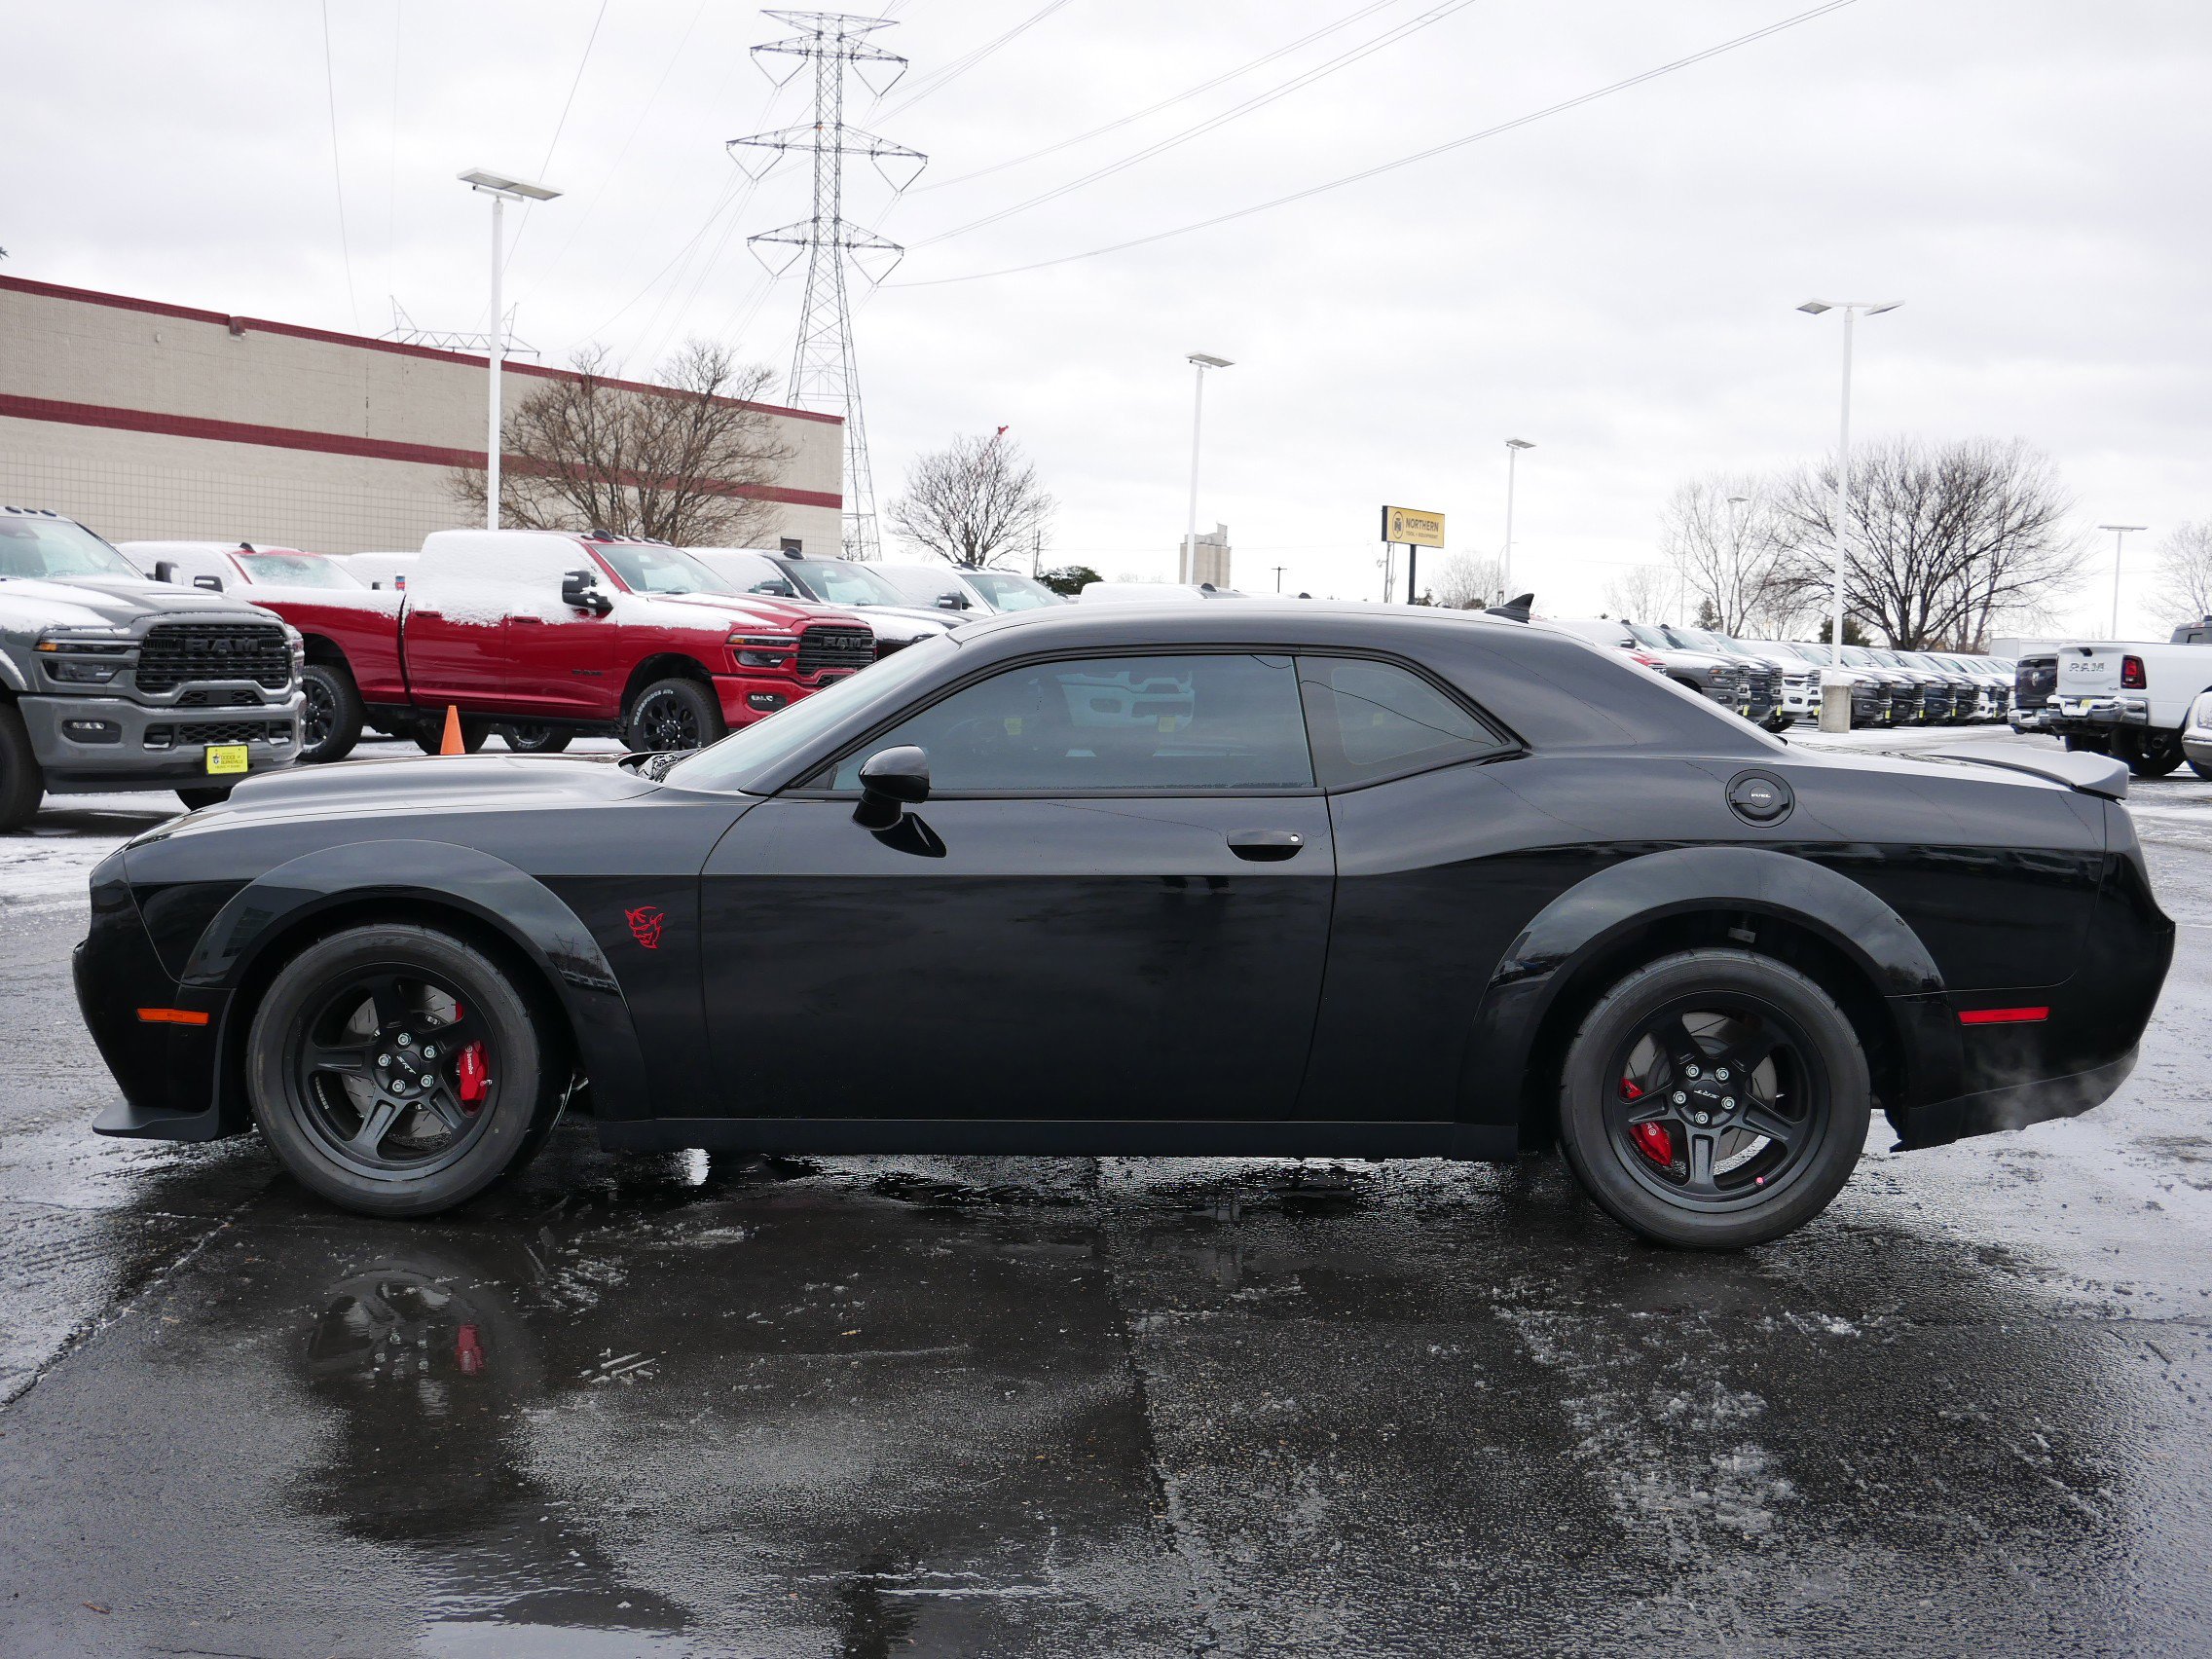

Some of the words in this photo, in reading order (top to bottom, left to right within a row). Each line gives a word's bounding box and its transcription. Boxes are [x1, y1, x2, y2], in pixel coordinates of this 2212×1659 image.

[1406, 518, 1439, 532] NORTHERN
[185, 639, 258, 652] RAM
[823, 636, 862, 647] RAM
[2069, 662, 2105, 672] RAM
[396, 1055, 417, 1075] SRT
